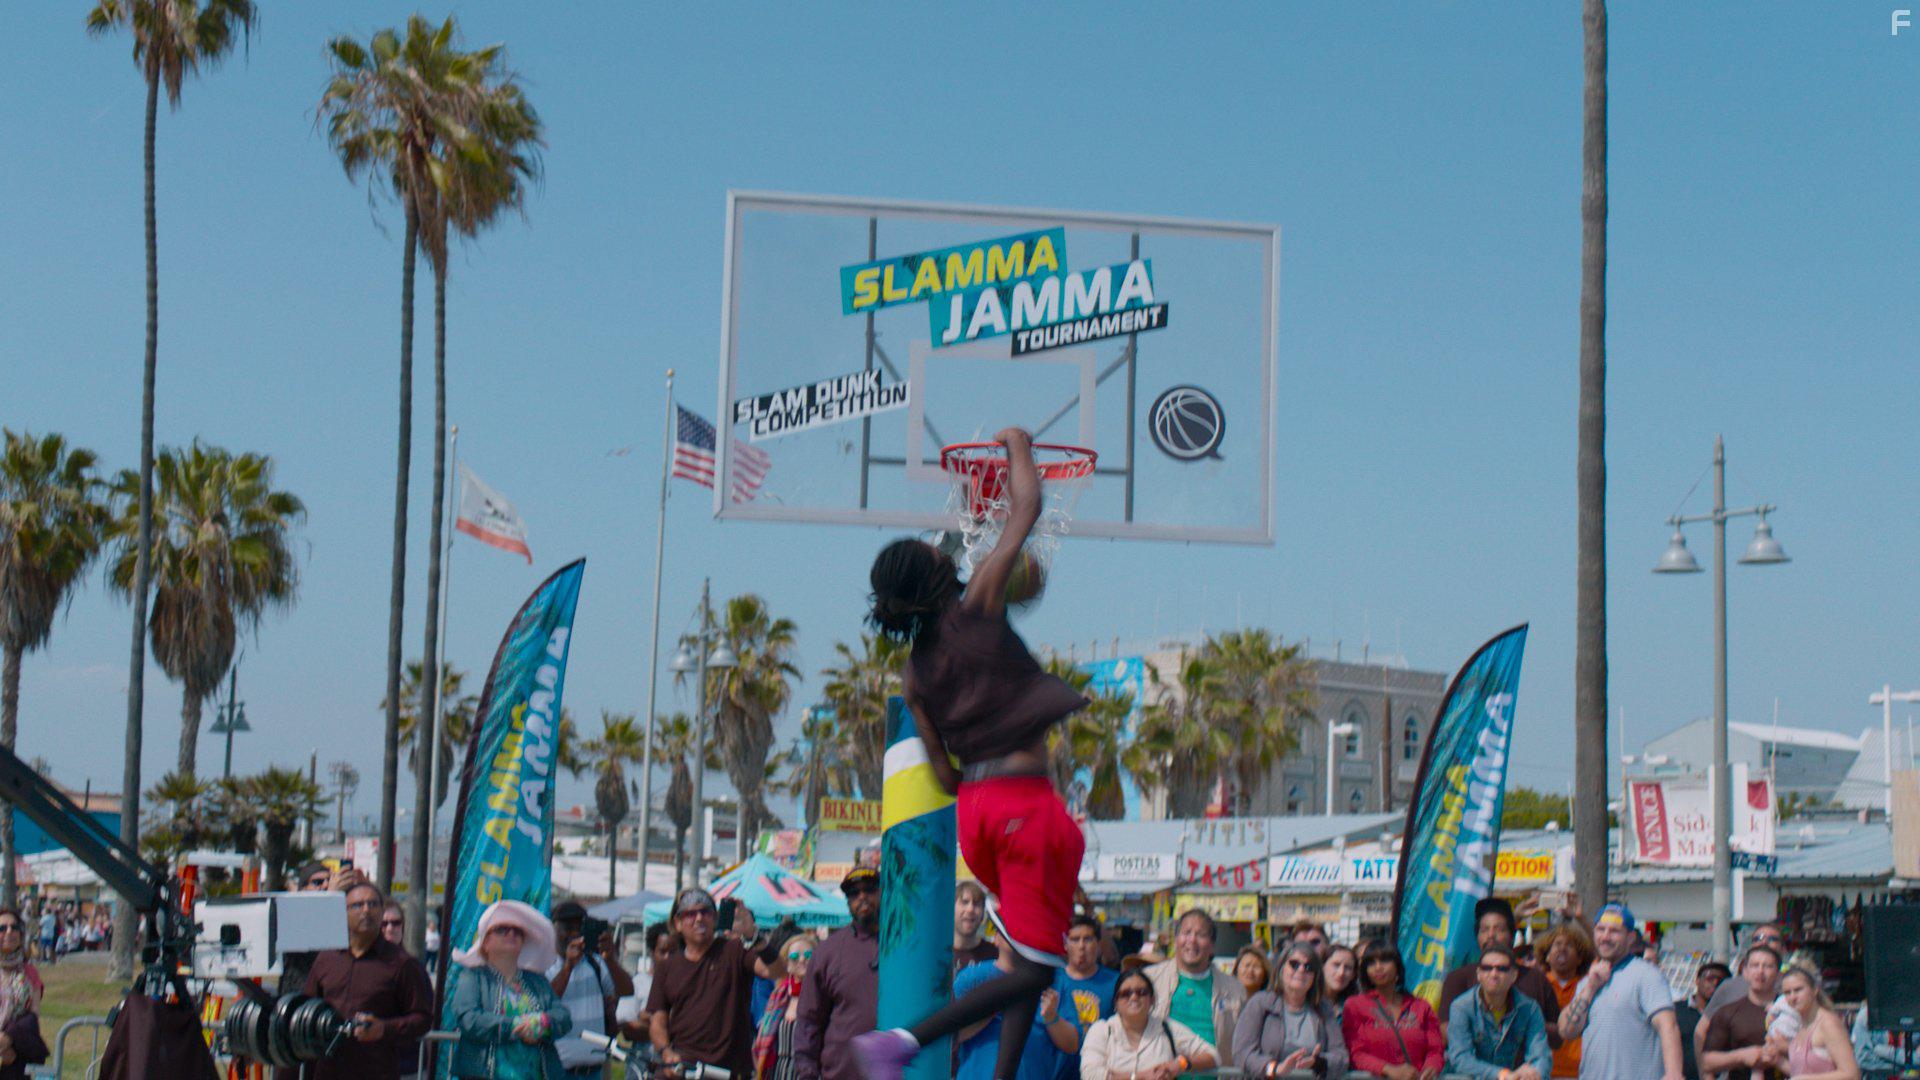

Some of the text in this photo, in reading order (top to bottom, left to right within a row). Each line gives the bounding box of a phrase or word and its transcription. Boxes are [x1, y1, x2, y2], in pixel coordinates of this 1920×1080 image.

[853, 235, 1059, 309] SLAMMA
[943, 259, 1155, 343] JAMMA
[1016, 305, 1163, 353] TOURNAMENT
[737, 368, 880, 424] SLAM DUNK
[754, 382, 908, 436] COMPETITION
[516, 626, 569, 846] JAMMA
[476, 700, 528, 906] SLAMMA
[823, 799, 873, 822] BIKINI
[1641, 784, 1664, 858] VENICE
[1194, 820, 1265, 847] TITI'S
[1113, 856, 1161, 870] POSTERS
[1187, 857, 1262, 889] TACOS
[1278, 855, 1340, 881] Henna
[1353, 858, 1396, 879] TATT
[1415, 764, 1471, 971] SLAMMA
[1497, 858, 1549, 876] OTION
